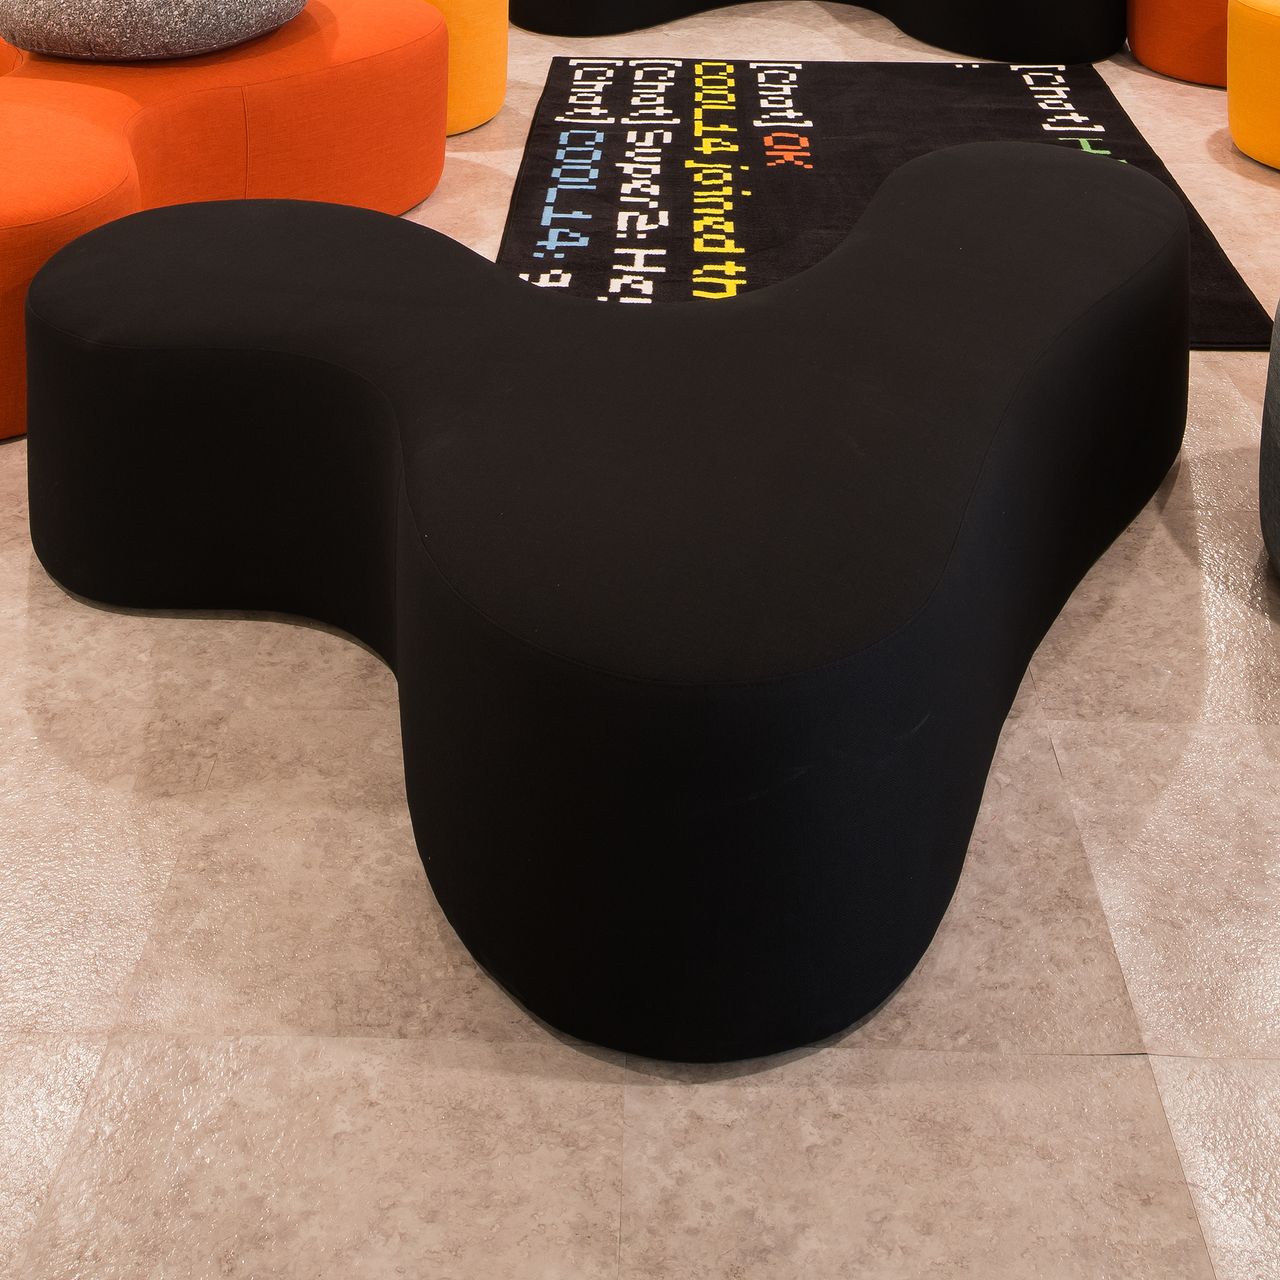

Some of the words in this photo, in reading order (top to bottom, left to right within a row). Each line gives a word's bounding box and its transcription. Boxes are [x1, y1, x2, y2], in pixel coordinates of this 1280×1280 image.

[555, 60, 623, 124] [Chat]
[620, 60, 682, 124] [Chat]
[694, 62, 739, 154] COOL14
[749, 63, 813, 127] [Chat]
[763, 132, 813, 169] OK
[685, 160, 751, 253] joined
